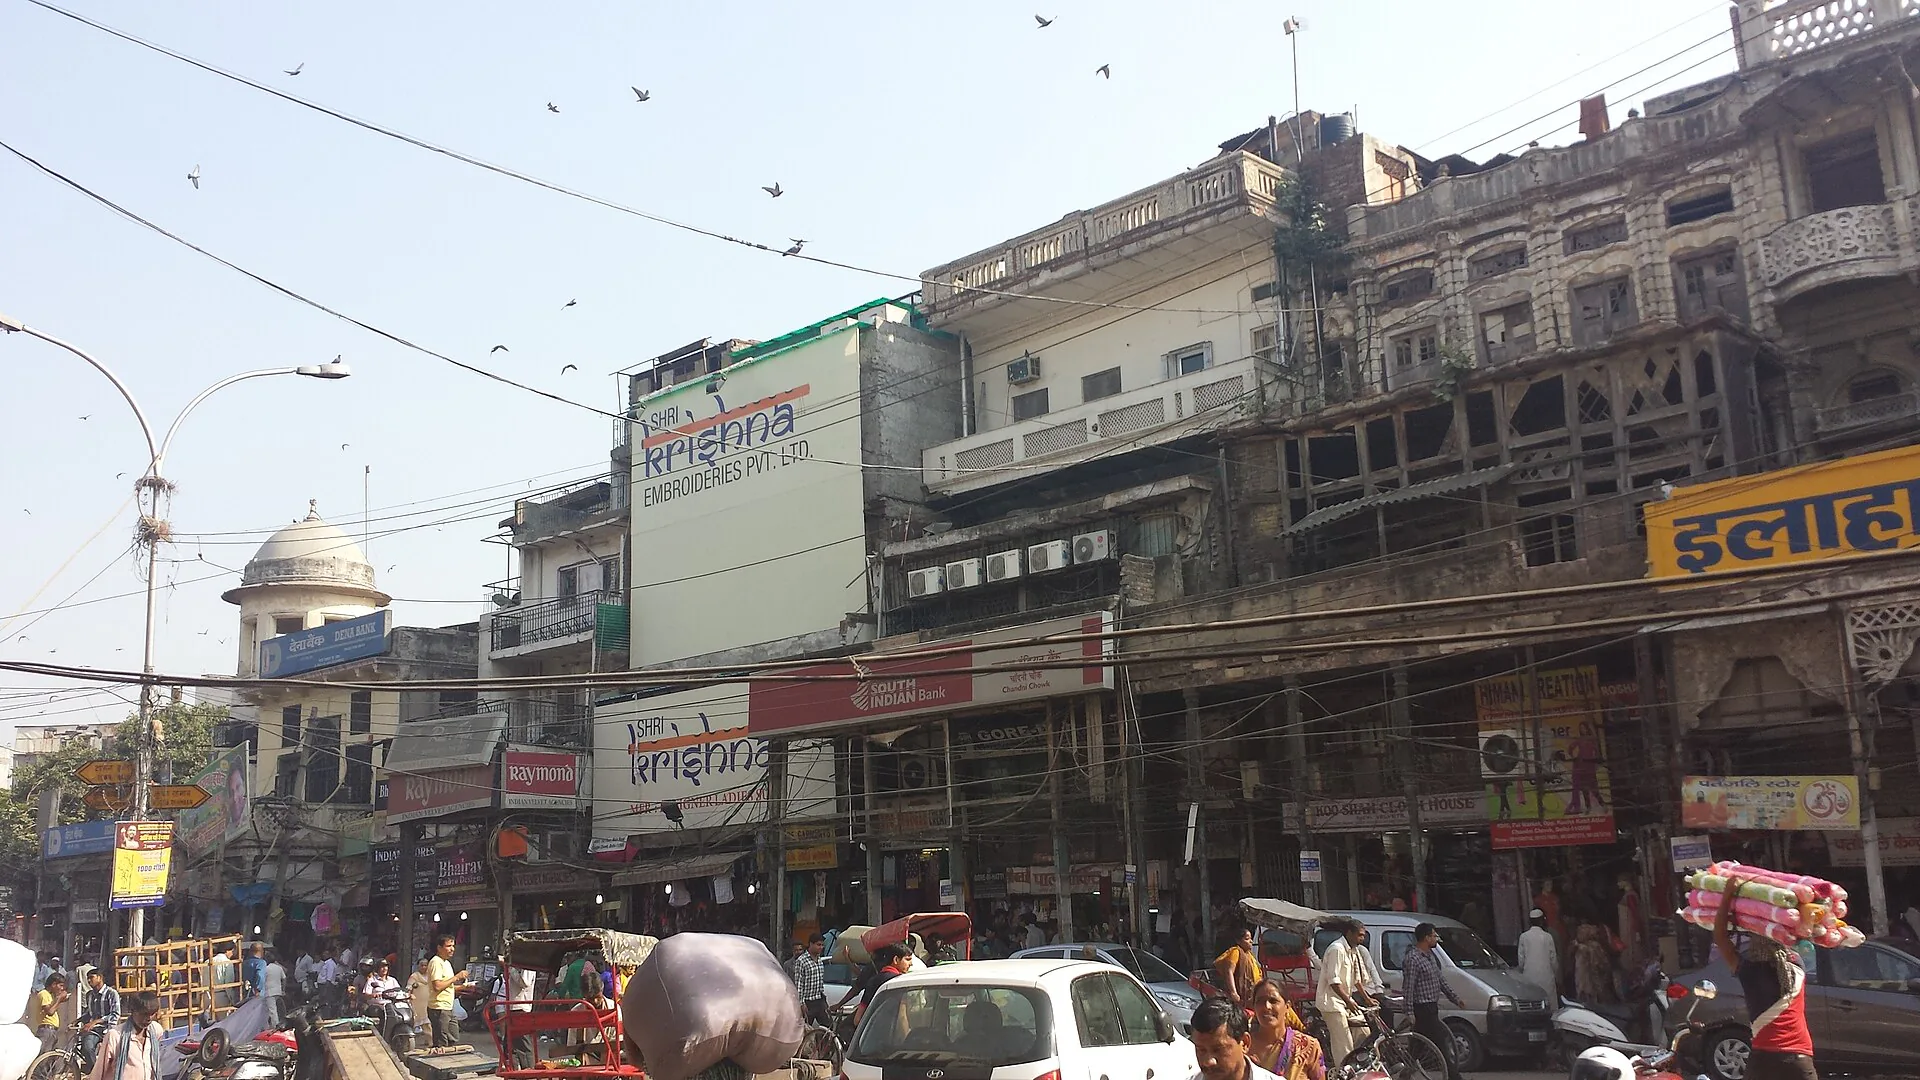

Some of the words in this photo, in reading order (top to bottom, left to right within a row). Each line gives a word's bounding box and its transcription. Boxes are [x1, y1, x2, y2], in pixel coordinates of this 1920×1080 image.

[651, 405, 679, 432] SHRI
[641, 394, 794, 478] krishna
[644, 460, 742, 508] EMBROIDERIES
[746, 450, 777, 477] PVT.
[781, 440, 814, 467] LTD.
[334, 627, 355, 642] DENA
[355, 622, 376, 637] BANK
[870, 678, 916, 694] SOUTH
[1002, 683, 1028, 694] Chandni
[1028, 680, 1051, 690] Chowk
[1536, 669, 1595, 699] REATION
[870, 689, 916, 709] INDIAN
[918, 686, 946, 702] Bank
[637, 716, 664, 738] SHRI
[508, 764, 574, 786] Raymond
[1428, 797, 1475, 811] HOUSE
[439, 857, 483, 878] Bhairav
[413, 894, 436, 903] LVET
